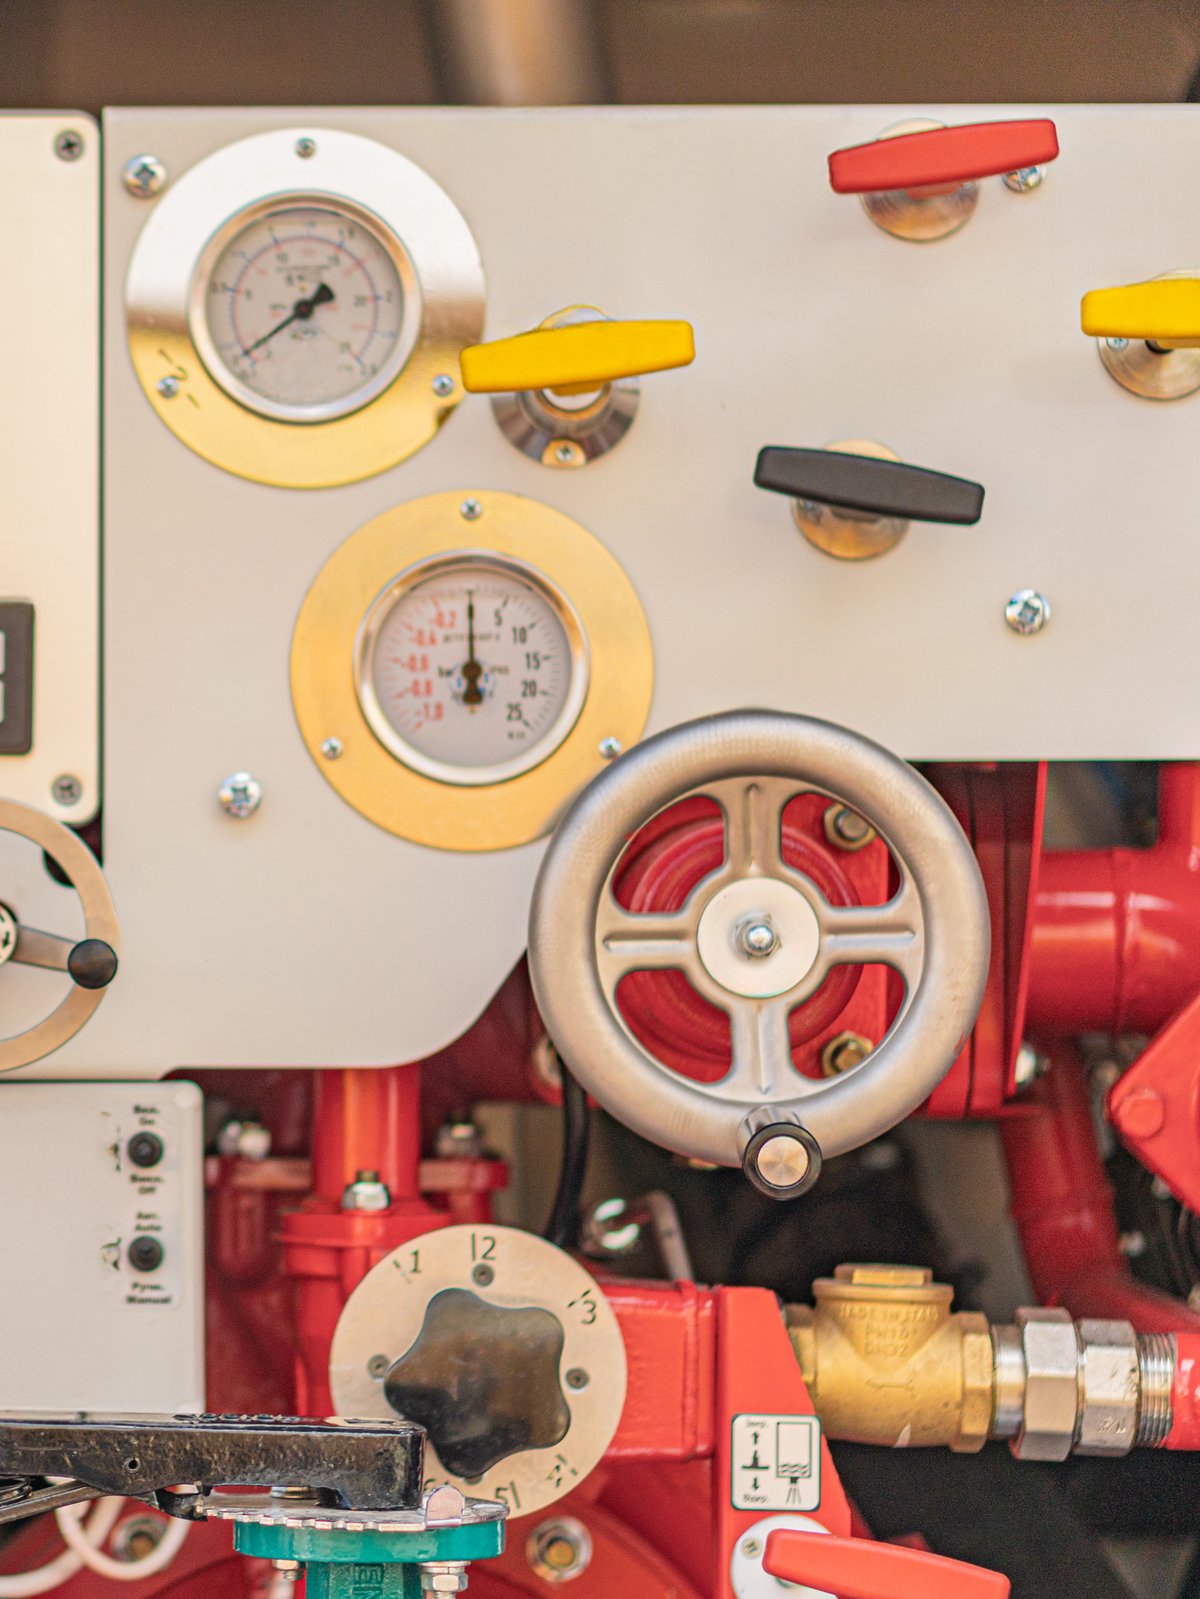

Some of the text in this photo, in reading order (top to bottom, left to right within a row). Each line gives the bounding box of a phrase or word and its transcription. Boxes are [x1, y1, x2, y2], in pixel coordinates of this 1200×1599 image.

[494, 607, 503, 627] 5
[512, 626, 527, 644] 10
[525, 651, 540, 670] 15
[521, 679, 537, 698] 20
[506, 702, 523, 721] 25
